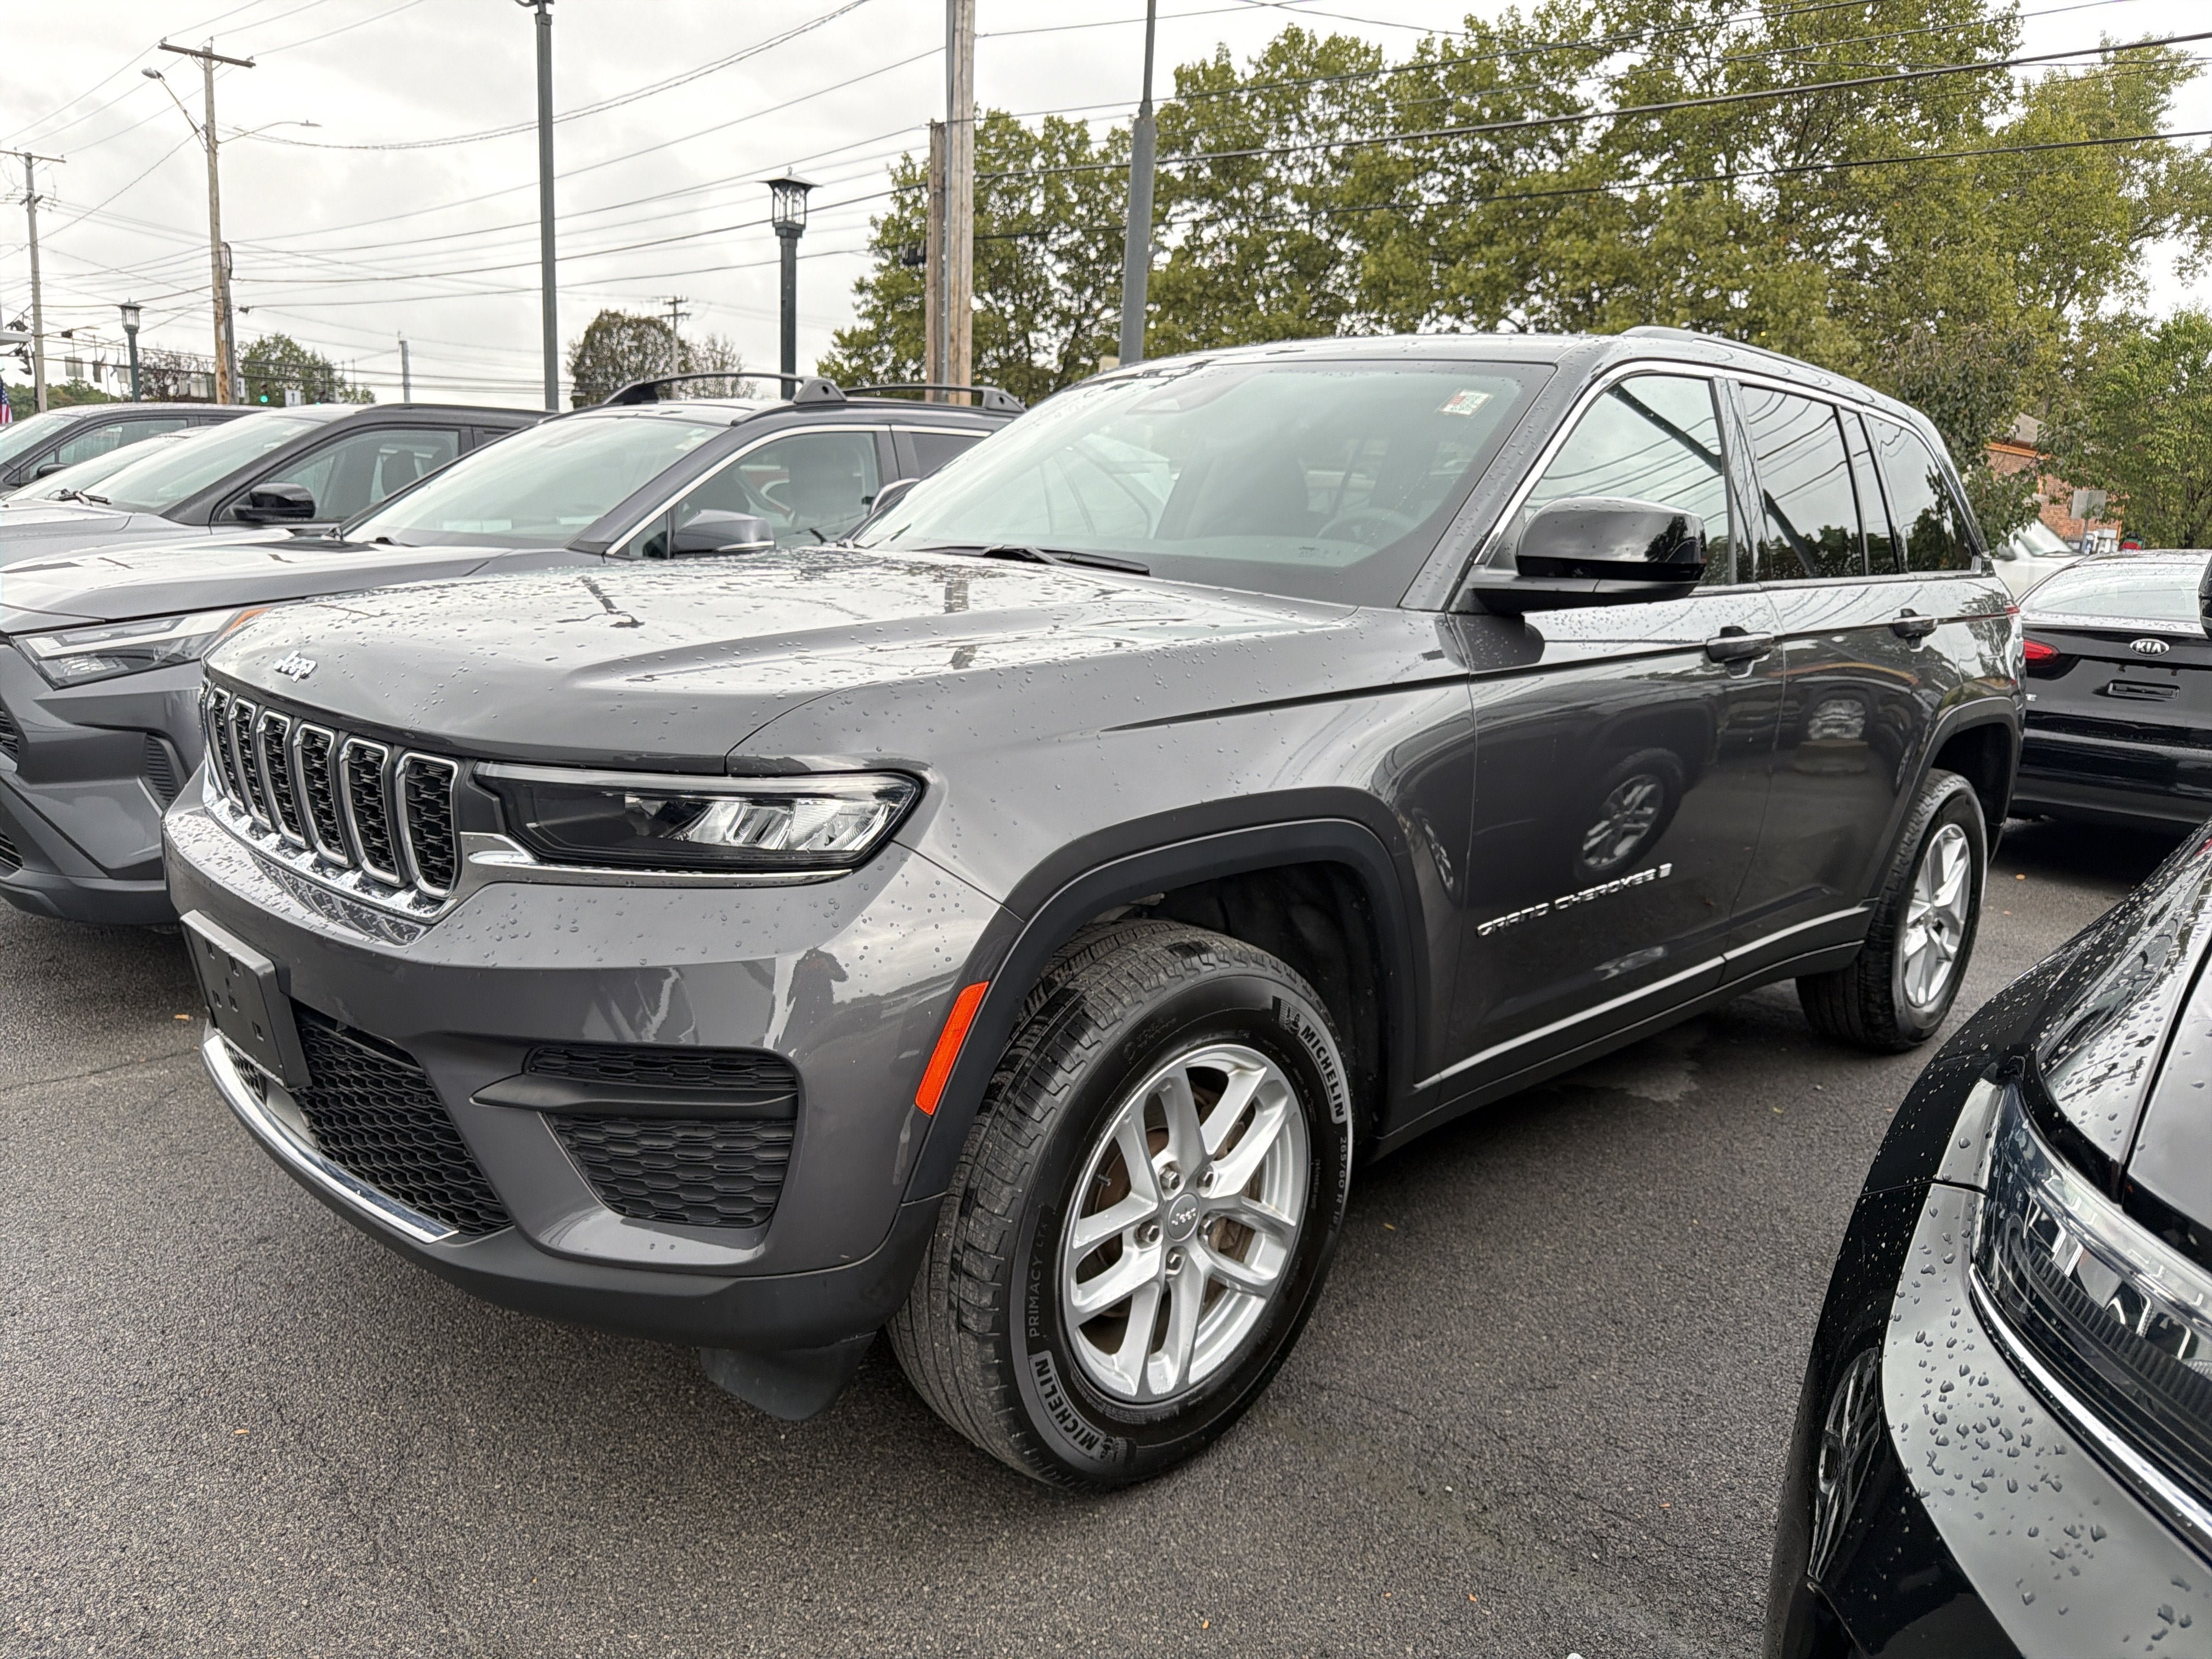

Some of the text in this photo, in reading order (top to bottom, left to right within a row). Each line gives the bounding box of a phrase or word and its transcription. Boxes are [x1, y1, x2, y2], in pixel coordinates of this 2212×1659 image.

[273, 650, 318, 682] Jeep
[2135, 641, 2162, 653] KIA
[1476, 868, 1657, 938] GRAND CHEROKEE
[1300, 1024, 1345, 1118] MICHELIN
[1029, 1256, 1043, 1338] PRIMACY
[1034, 1359, 1101, 1452] MICHELIN
